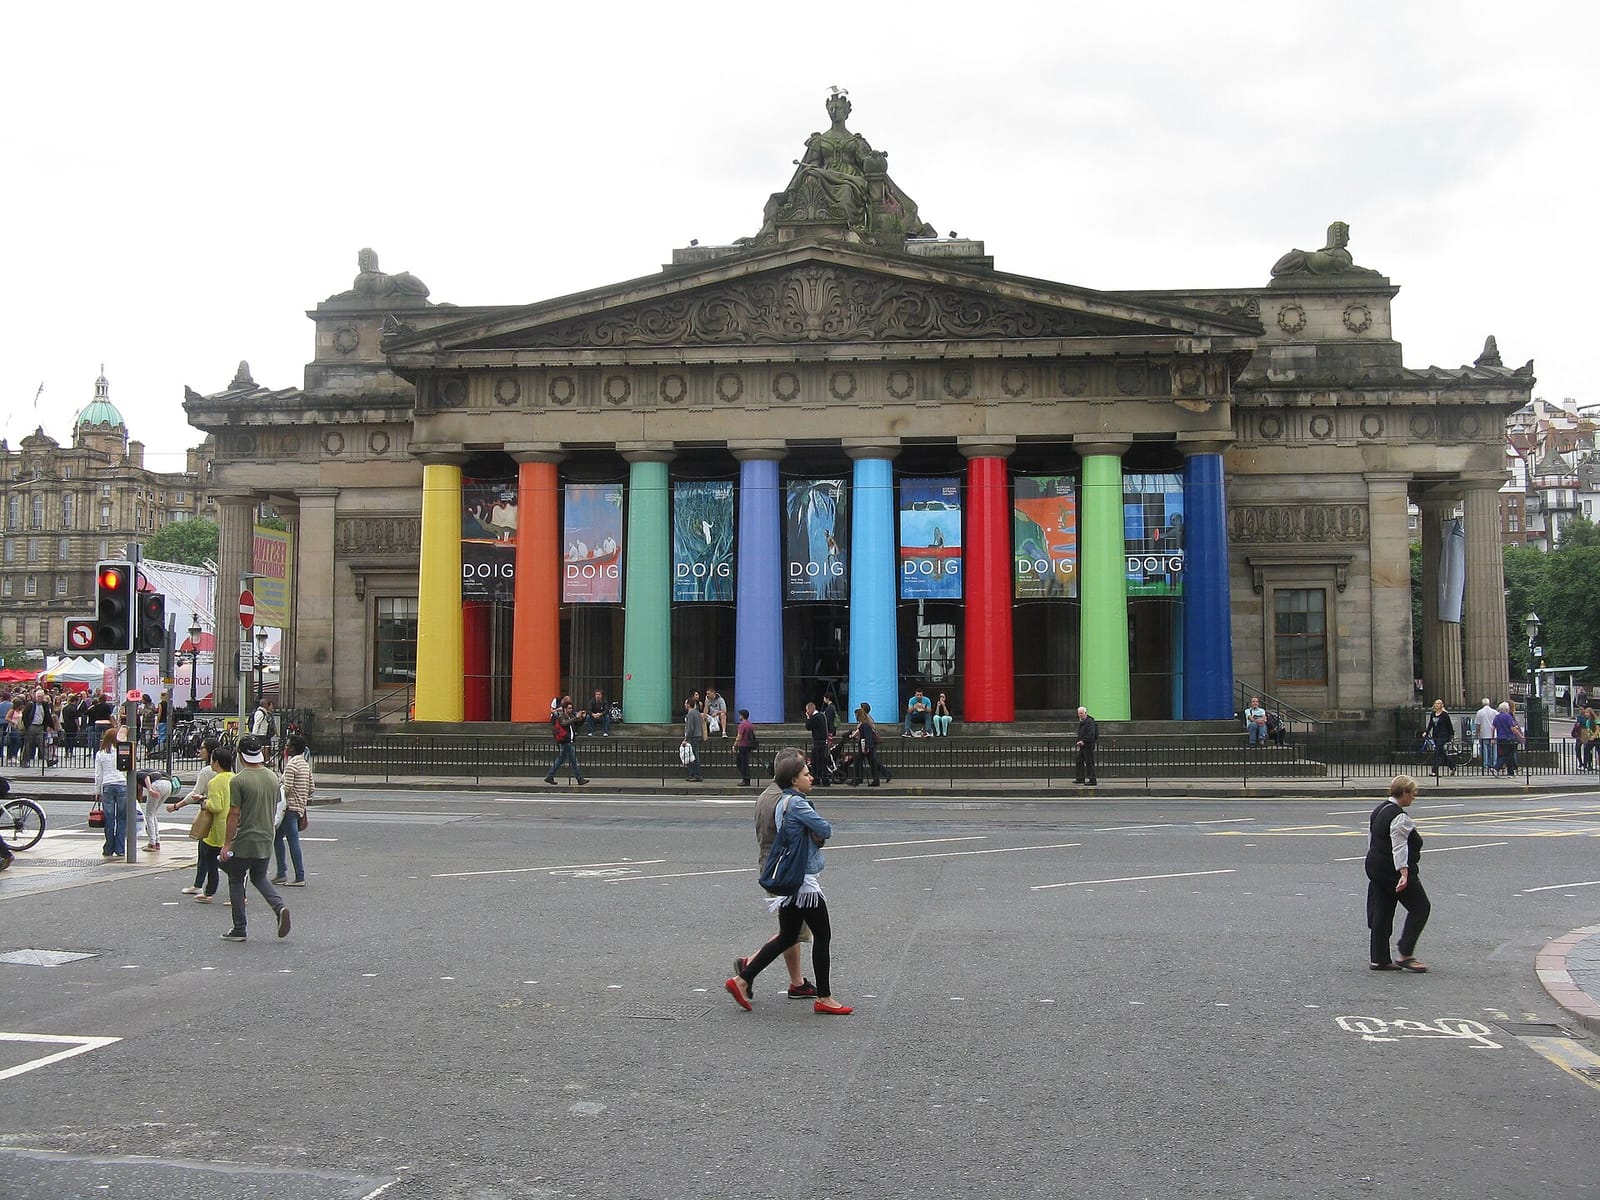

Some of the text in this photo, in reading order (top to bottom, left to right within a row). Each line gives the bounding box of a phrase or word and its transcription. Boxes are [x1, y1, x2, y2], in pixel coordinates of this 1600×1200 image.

[463, 563, 514, 578] DOIG
[567, 564, 619, 579] DOIG
[677, 562, 730, 577] DOIG
[790, 561, 844, 576] DOIG
[904, 560, 958, 575] DOIG
[1018, 559, 1073, 574] DOIG
[1128, 557, 1182, 572] DOIG
